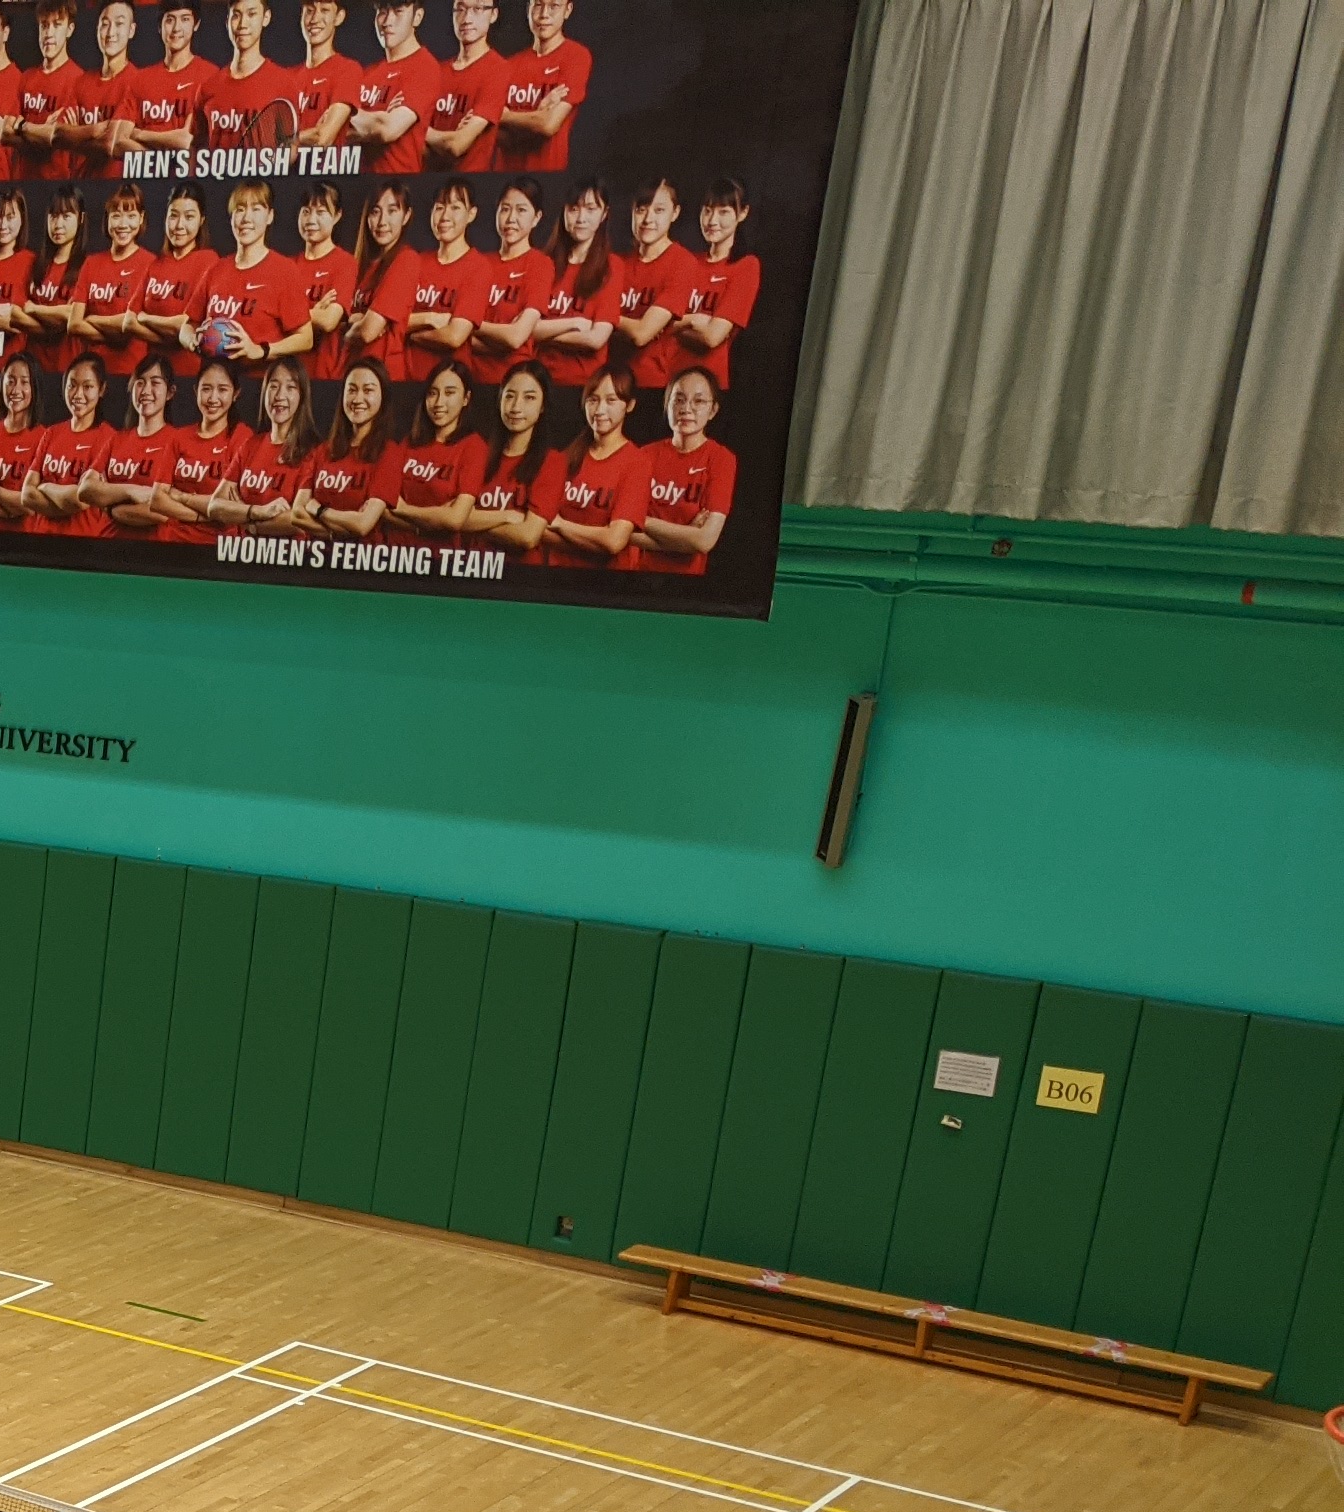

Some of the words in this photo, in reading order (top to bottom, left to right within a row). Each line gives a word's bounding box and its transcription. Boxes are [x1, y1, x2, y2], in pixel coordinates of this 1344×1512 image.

[123, 149, 189, 179] MEN'S
[196, 147, 290, 180] SQUASH
[298, 146, 361, 176] TEAM
[217, 535, 325, 567] WOMEN'S
[330, 542, 431, 577] FENCING
[439, 548, 505, 581] TEAM
[1046, 1078, 1097, 1105] B06
